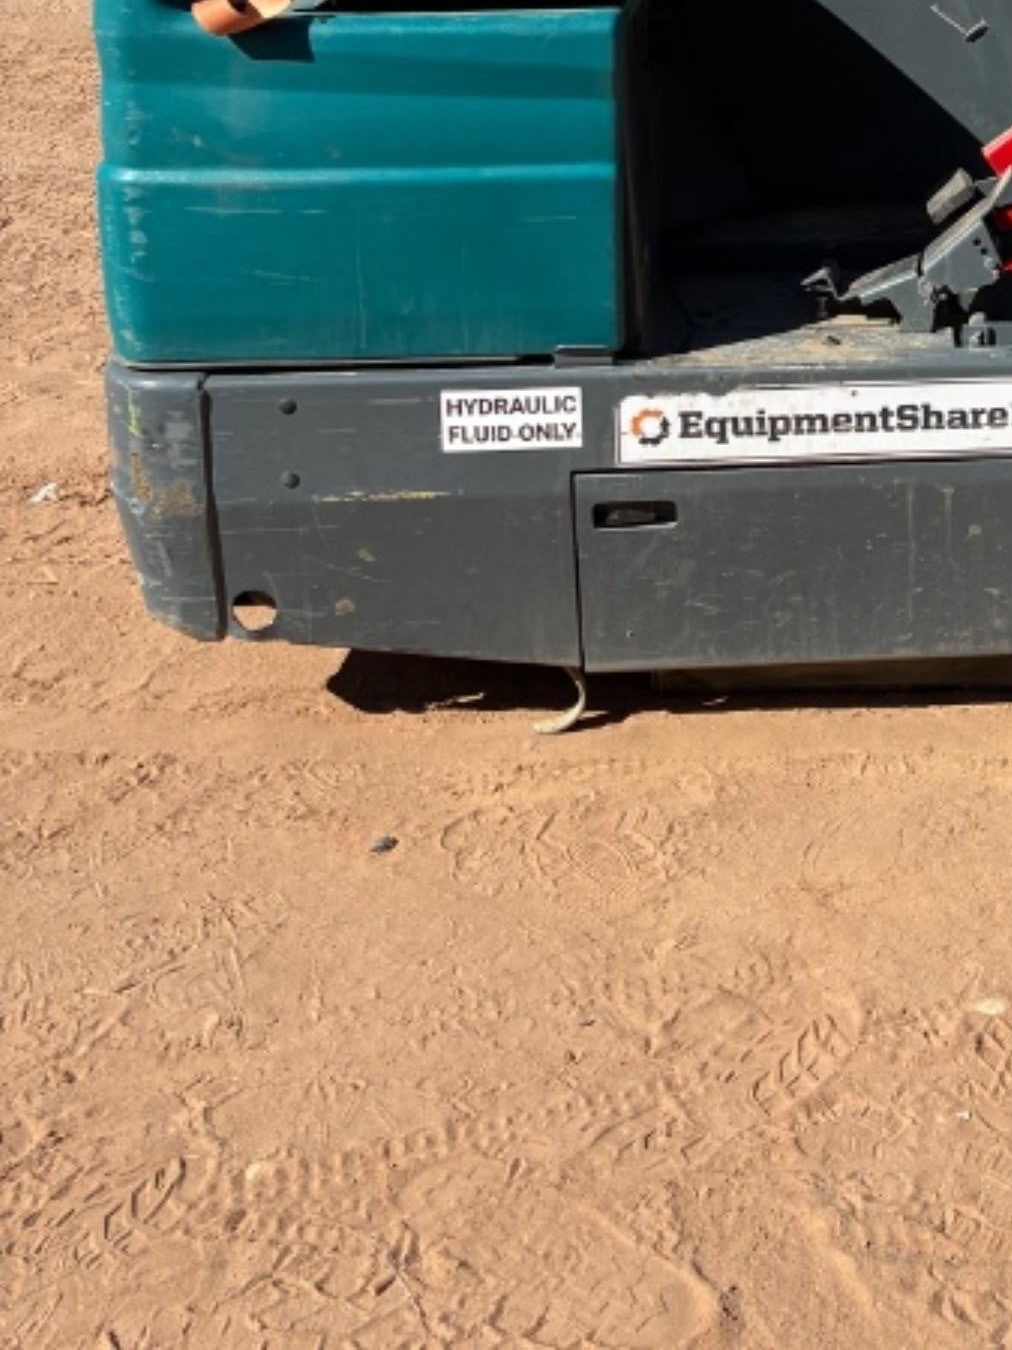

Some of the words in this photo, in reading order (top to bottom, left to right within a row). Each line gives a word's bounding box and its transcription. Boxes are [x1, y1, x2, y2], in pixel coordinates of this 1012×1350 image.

[446, 396, 576, 417] HYDRAULIC
[448, 424, 512, 444] FLUID
[518, 422, 577, 442] ONLY
[677, 404, 1008, 446] EquipmentShare
